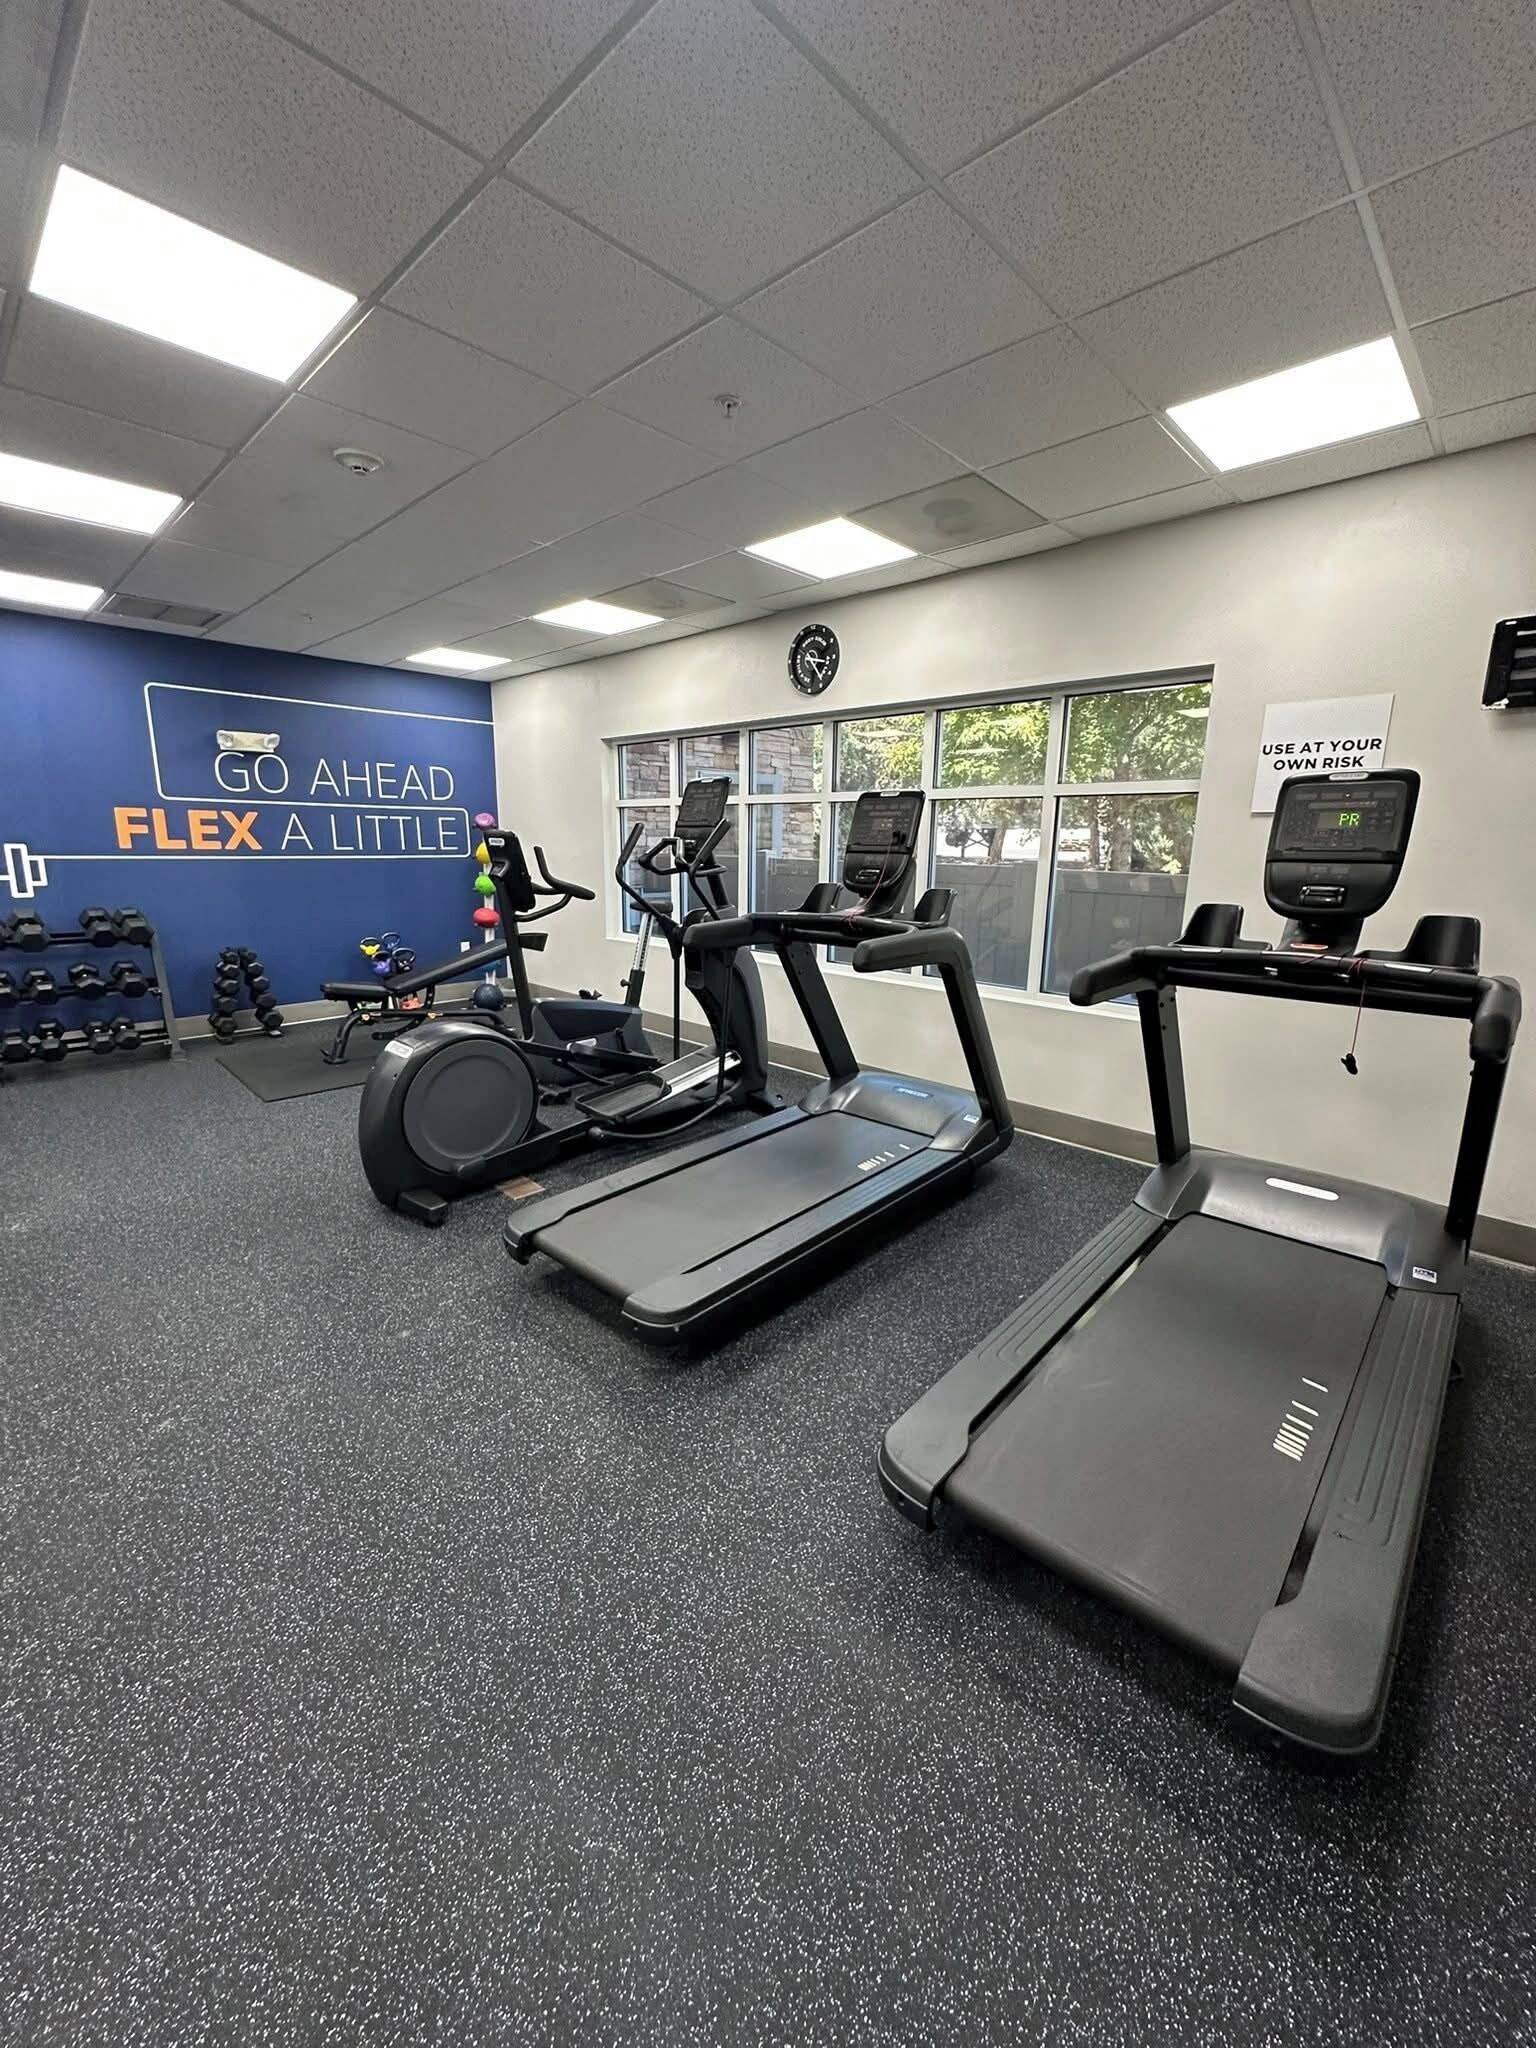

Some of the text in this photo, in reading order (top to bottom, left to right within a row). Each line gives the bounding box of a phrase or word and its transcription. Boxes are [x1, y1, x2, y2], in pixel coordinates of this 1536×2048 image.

[1262, 738, 1382, 755] USE AT YOUR
[1273, 755, 1365, 771] OWN RISK
[214, 751, 455, 801] GO AHEAD
[1338, 812, 1360, 826] PR
[113, 806, 459, 850] FLEX A LITTLE
